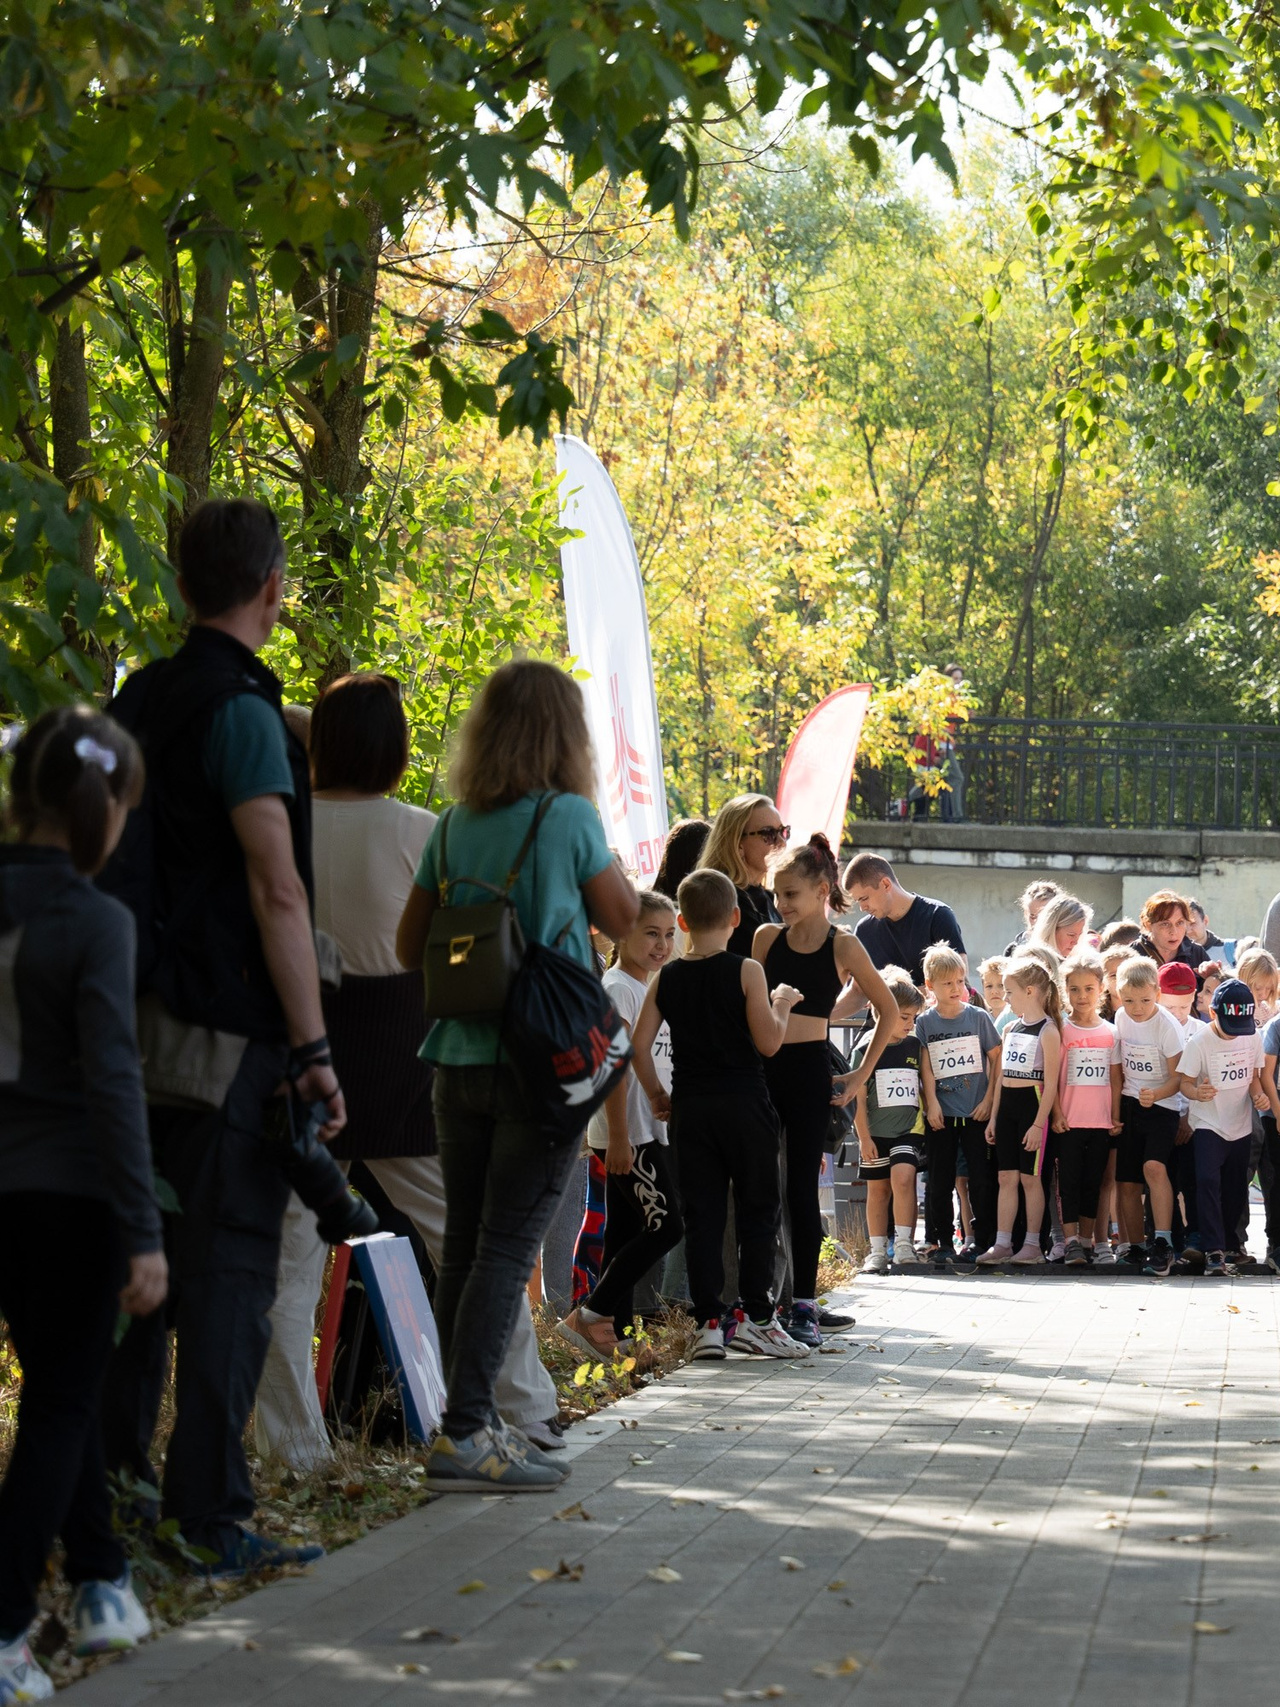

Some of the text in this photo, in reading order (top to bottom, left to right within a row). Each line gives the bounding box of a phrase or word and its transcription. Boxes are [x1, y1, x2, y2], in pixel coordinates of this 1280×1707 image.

[1223, 1002, 1254, 1016] YACHT
[939, 1054, 975, 1070] 7044
[1124, 1058, 1153, 1072] 7086
[1076, 1066, 1106, 1077] 7017
[1221, 1068, 1248, 1082] 7081
[887, 1086, 916, 1098] 7014
